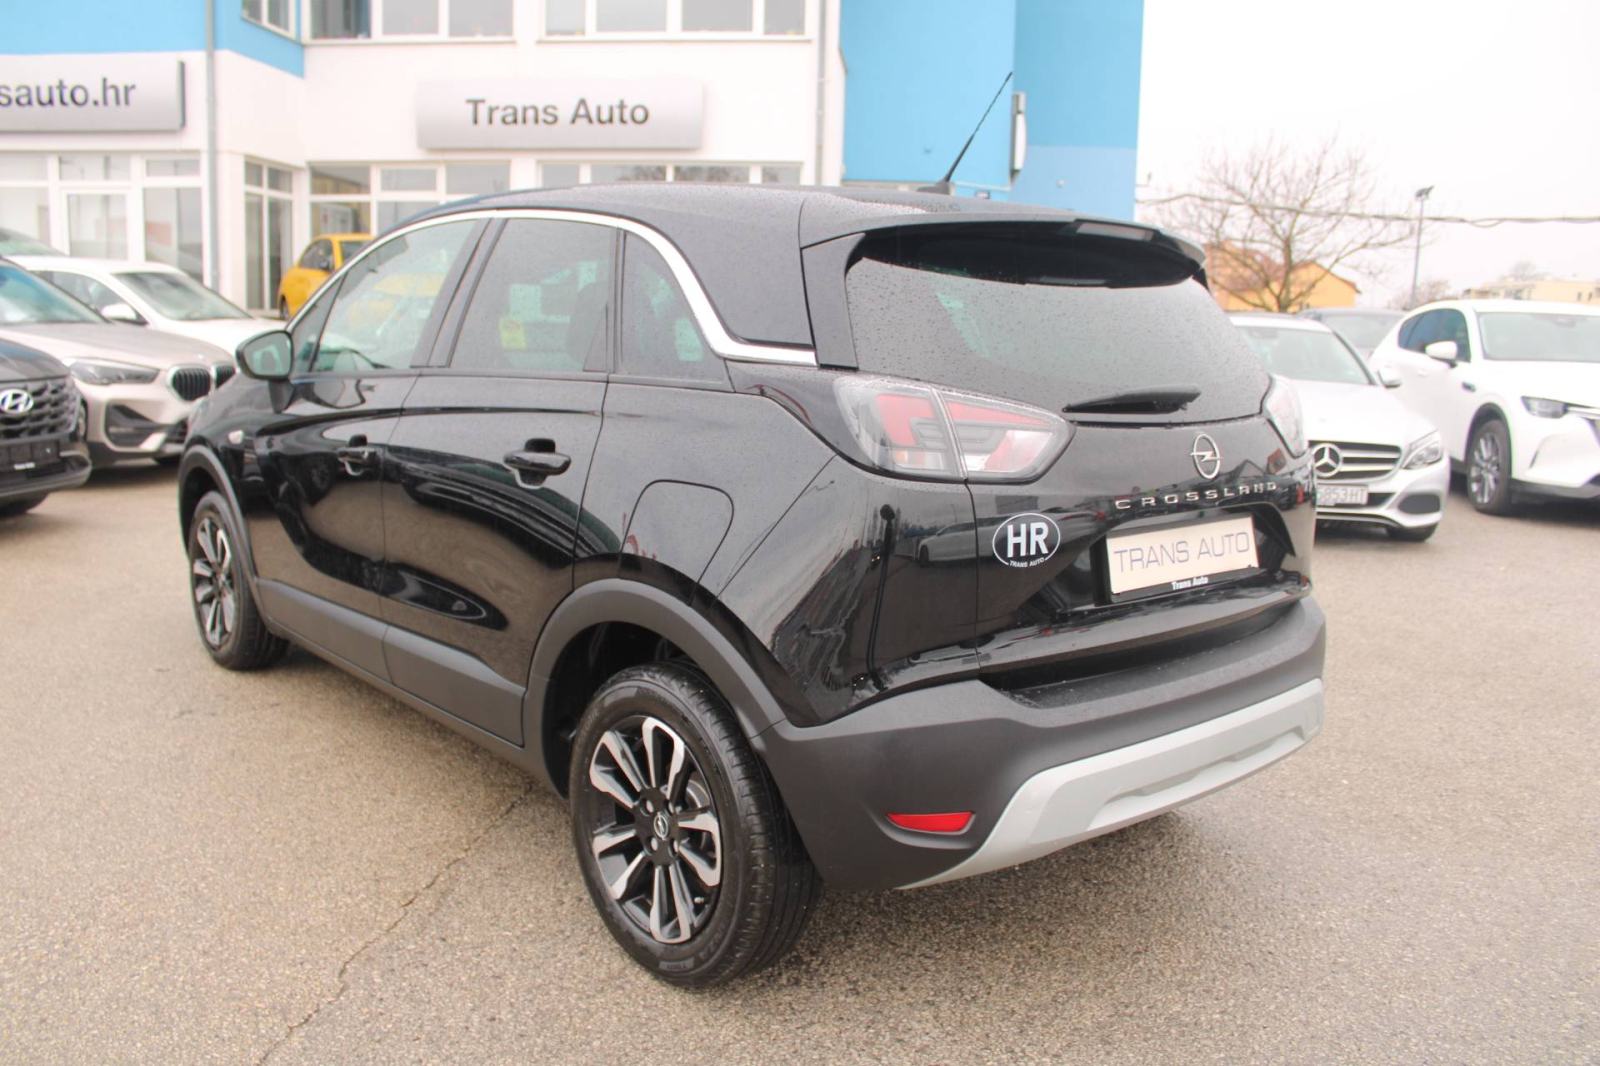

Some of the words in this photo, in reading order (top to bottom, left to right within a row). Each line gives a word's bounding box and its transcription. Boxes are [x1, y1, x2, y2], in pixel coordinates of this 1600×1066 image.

[0, 76, 136, 107] sauto.hr
[465, 98, 559, 126] Trans
[570, 97, 650, 126] Auto
[1114, 481, 1278, 510] CROSSLAND
[1007, 521, 1049, 558] HR
[1113, 540, 1190, 574] TRANS
[1197, 531, 1250, 561] AUTO
[1009, 560, 1028, 568] TRANS
[1029, 557, 1045, 567] AUTO
[1171, 580, 1192, 590] Trans
[1192, 576, 1209, 586] Auto
